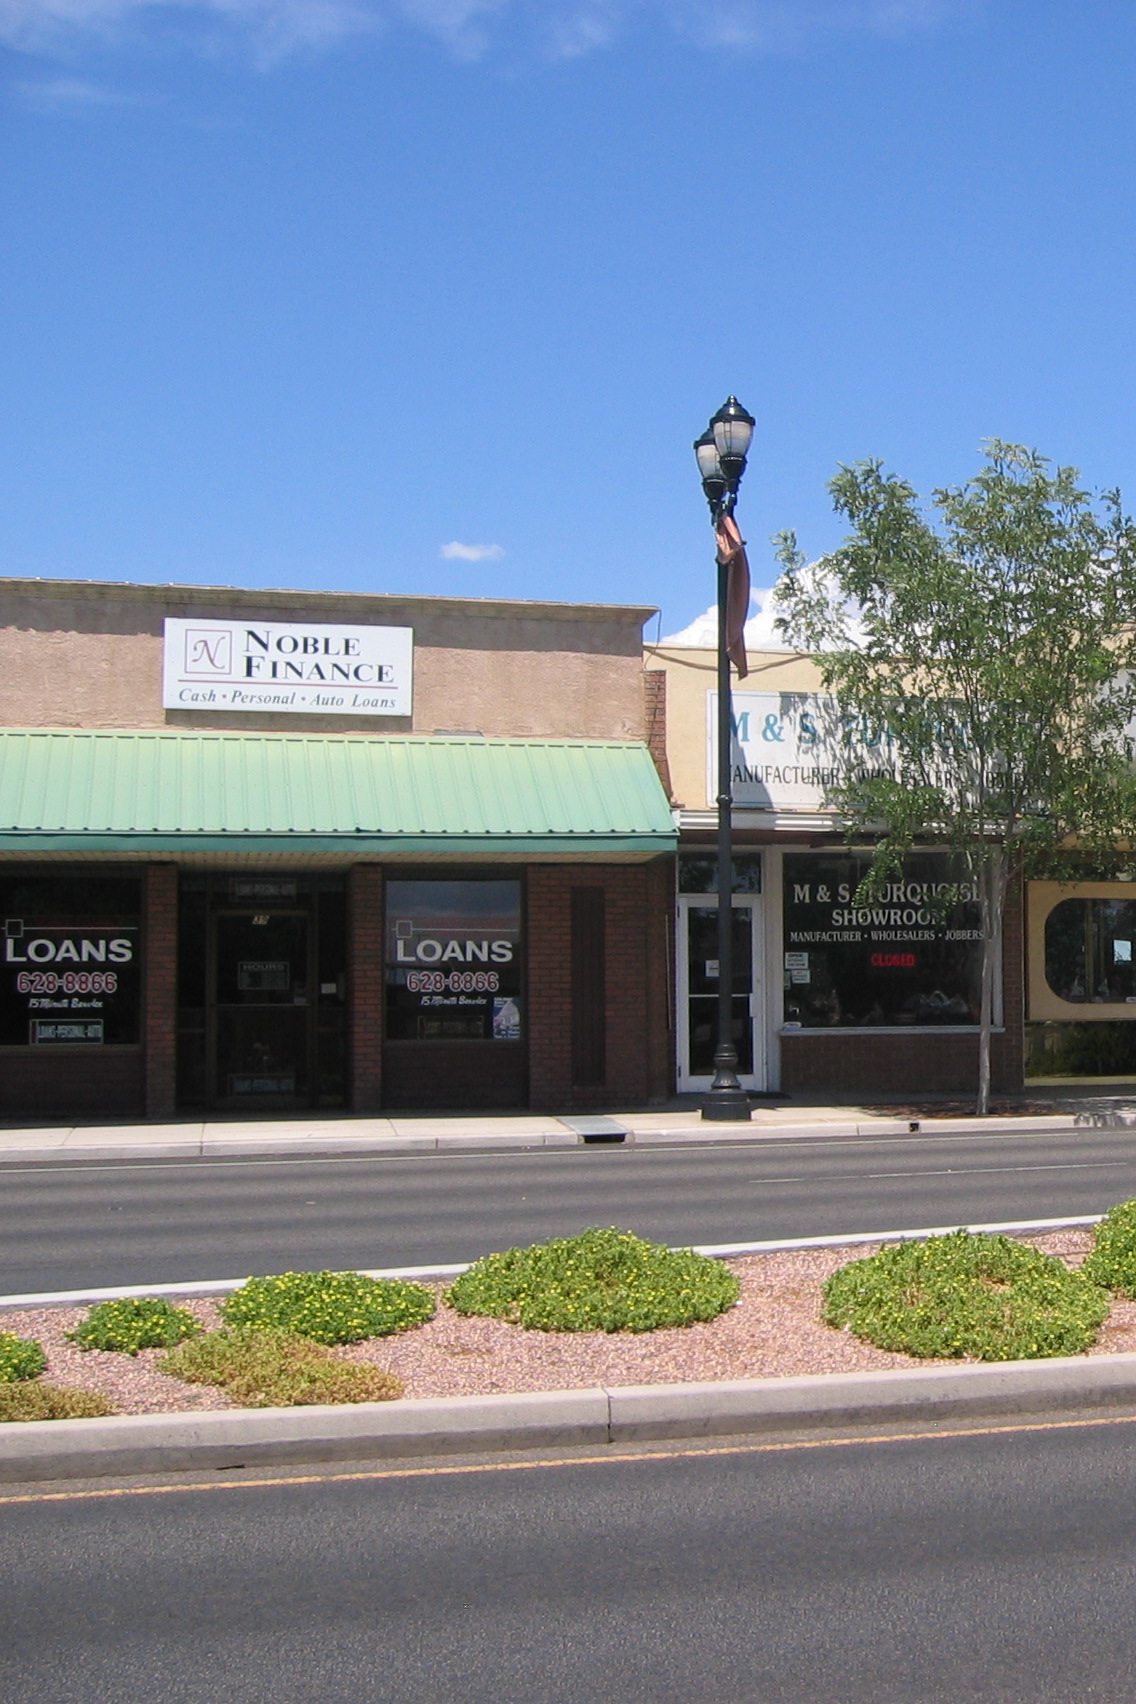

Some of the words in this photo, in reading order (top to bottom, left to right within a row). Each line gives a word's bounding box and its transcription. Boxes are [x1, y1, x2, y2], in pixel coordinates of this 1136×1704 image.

[243, 629, 361, 656] NOBLE
[243, 655, 395, 683] FINANCE
[179, 688, 216, 702] Cash
[231, 690, 296, 705] Personal
[309, 693, 344, 707] Auto
[351, 694, 397, 708] Loans
[762, 713, 785, 742] &
[799, 713, 816, 744] S
[729, 764, 840, 787] ANUFACTURER
[793, 884, 809, 903] M
[816, 884, 831, 903] &
[838, 883, 850, 903] S
[790, 931, 861, 942] MANUFACTURER
[870, 930, 935, 941] WHOLESALERS
[945, 930, 984, 941] JOBBERS
[6, 939, 133, 962] LOANS
[396, 939, 513, 962] LOANS
[870, 953, 916, 966] CLOSED
[17, 972, 118, 993] 628-8866
[407, 971, 499, 992] 628-8866
